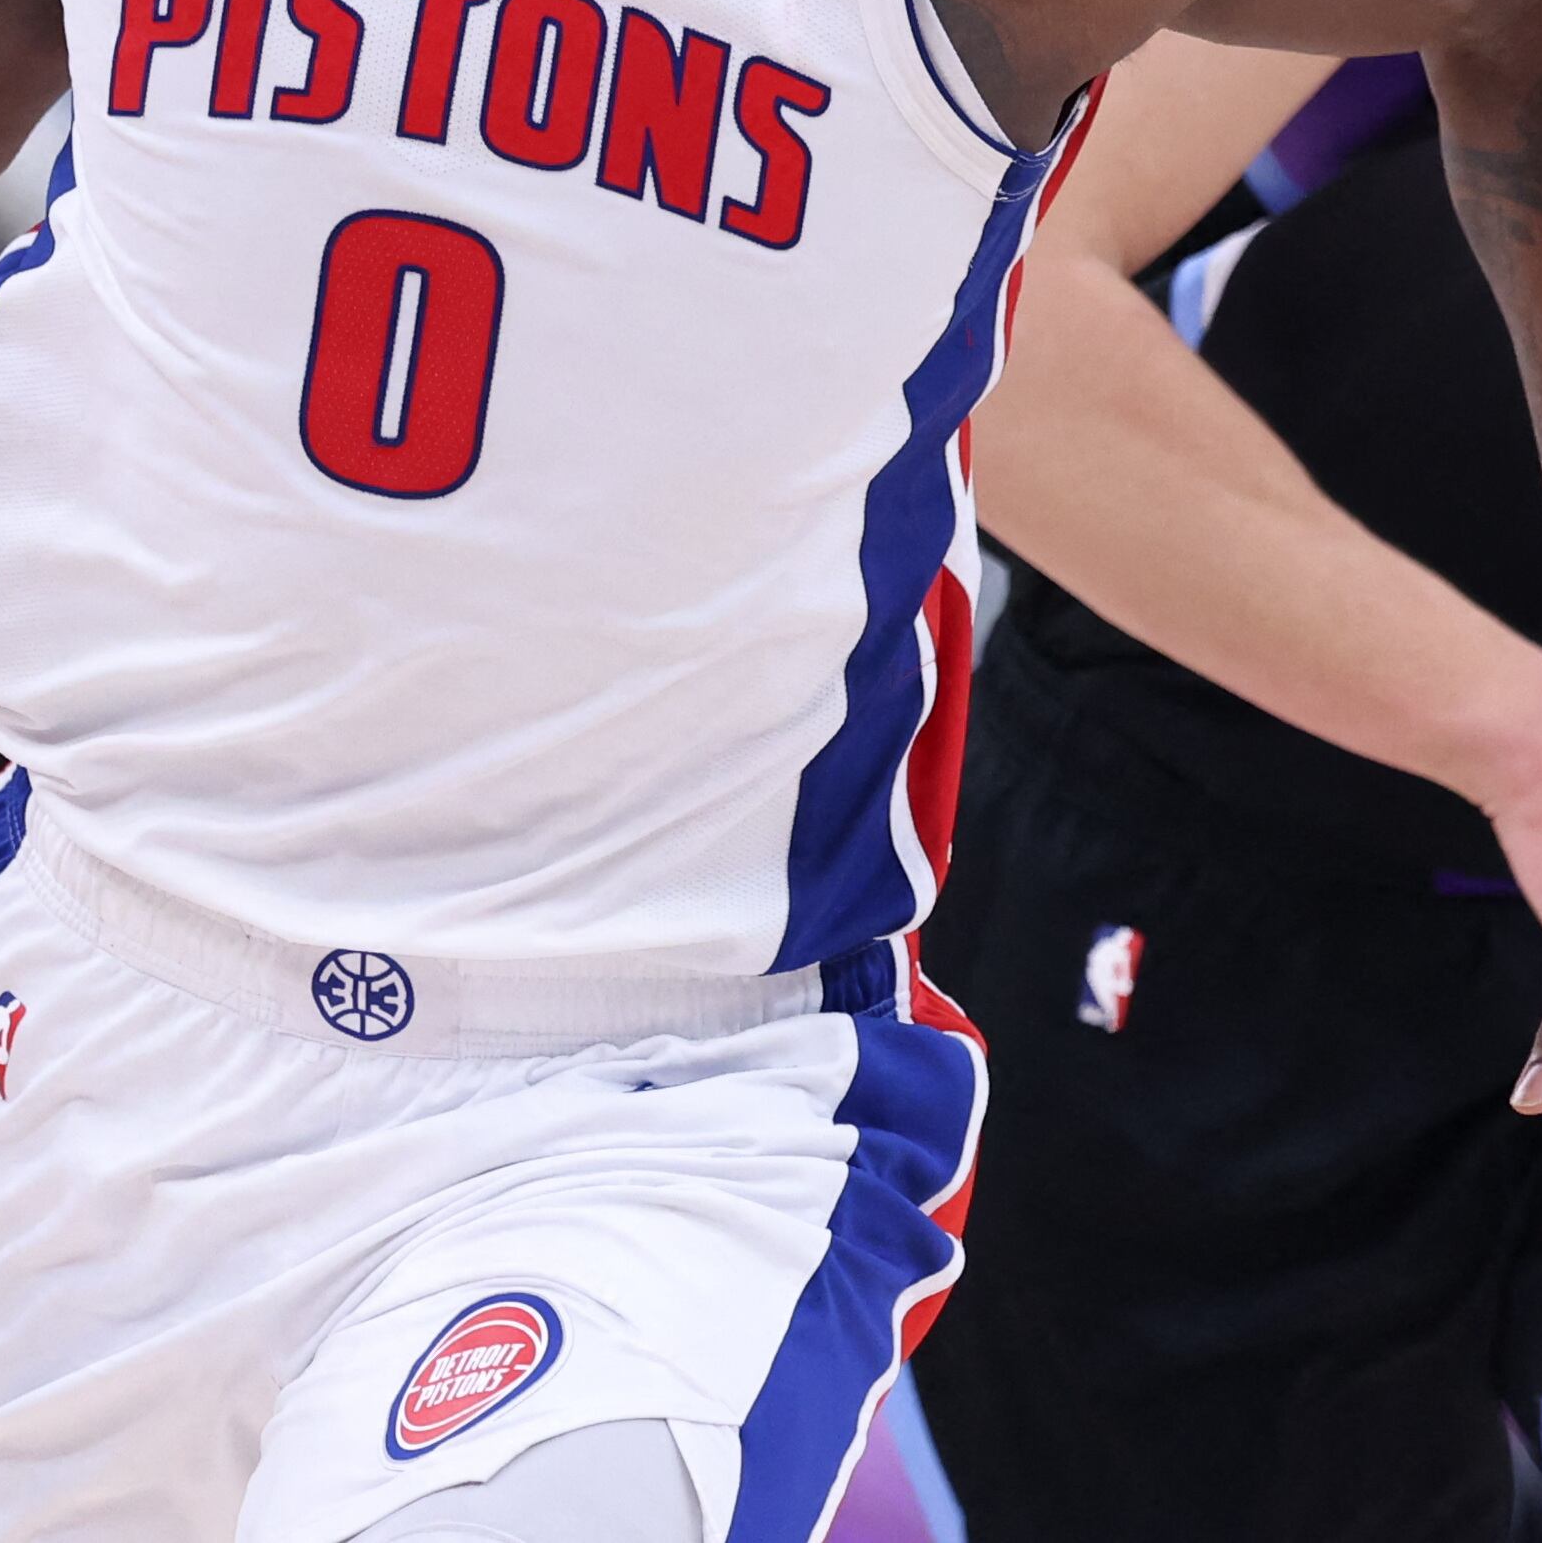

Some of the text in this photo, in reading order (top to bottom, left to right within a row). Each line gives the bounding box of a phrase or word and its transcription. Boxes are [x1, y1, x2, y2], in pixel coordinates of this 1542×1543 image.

[299, 209, 506, 500] 0
[318, 960, 408, 1027] 313
[413, 1368, 510, 1413] PISTONS
[428, 1343, 526, 1384] DETROIT
